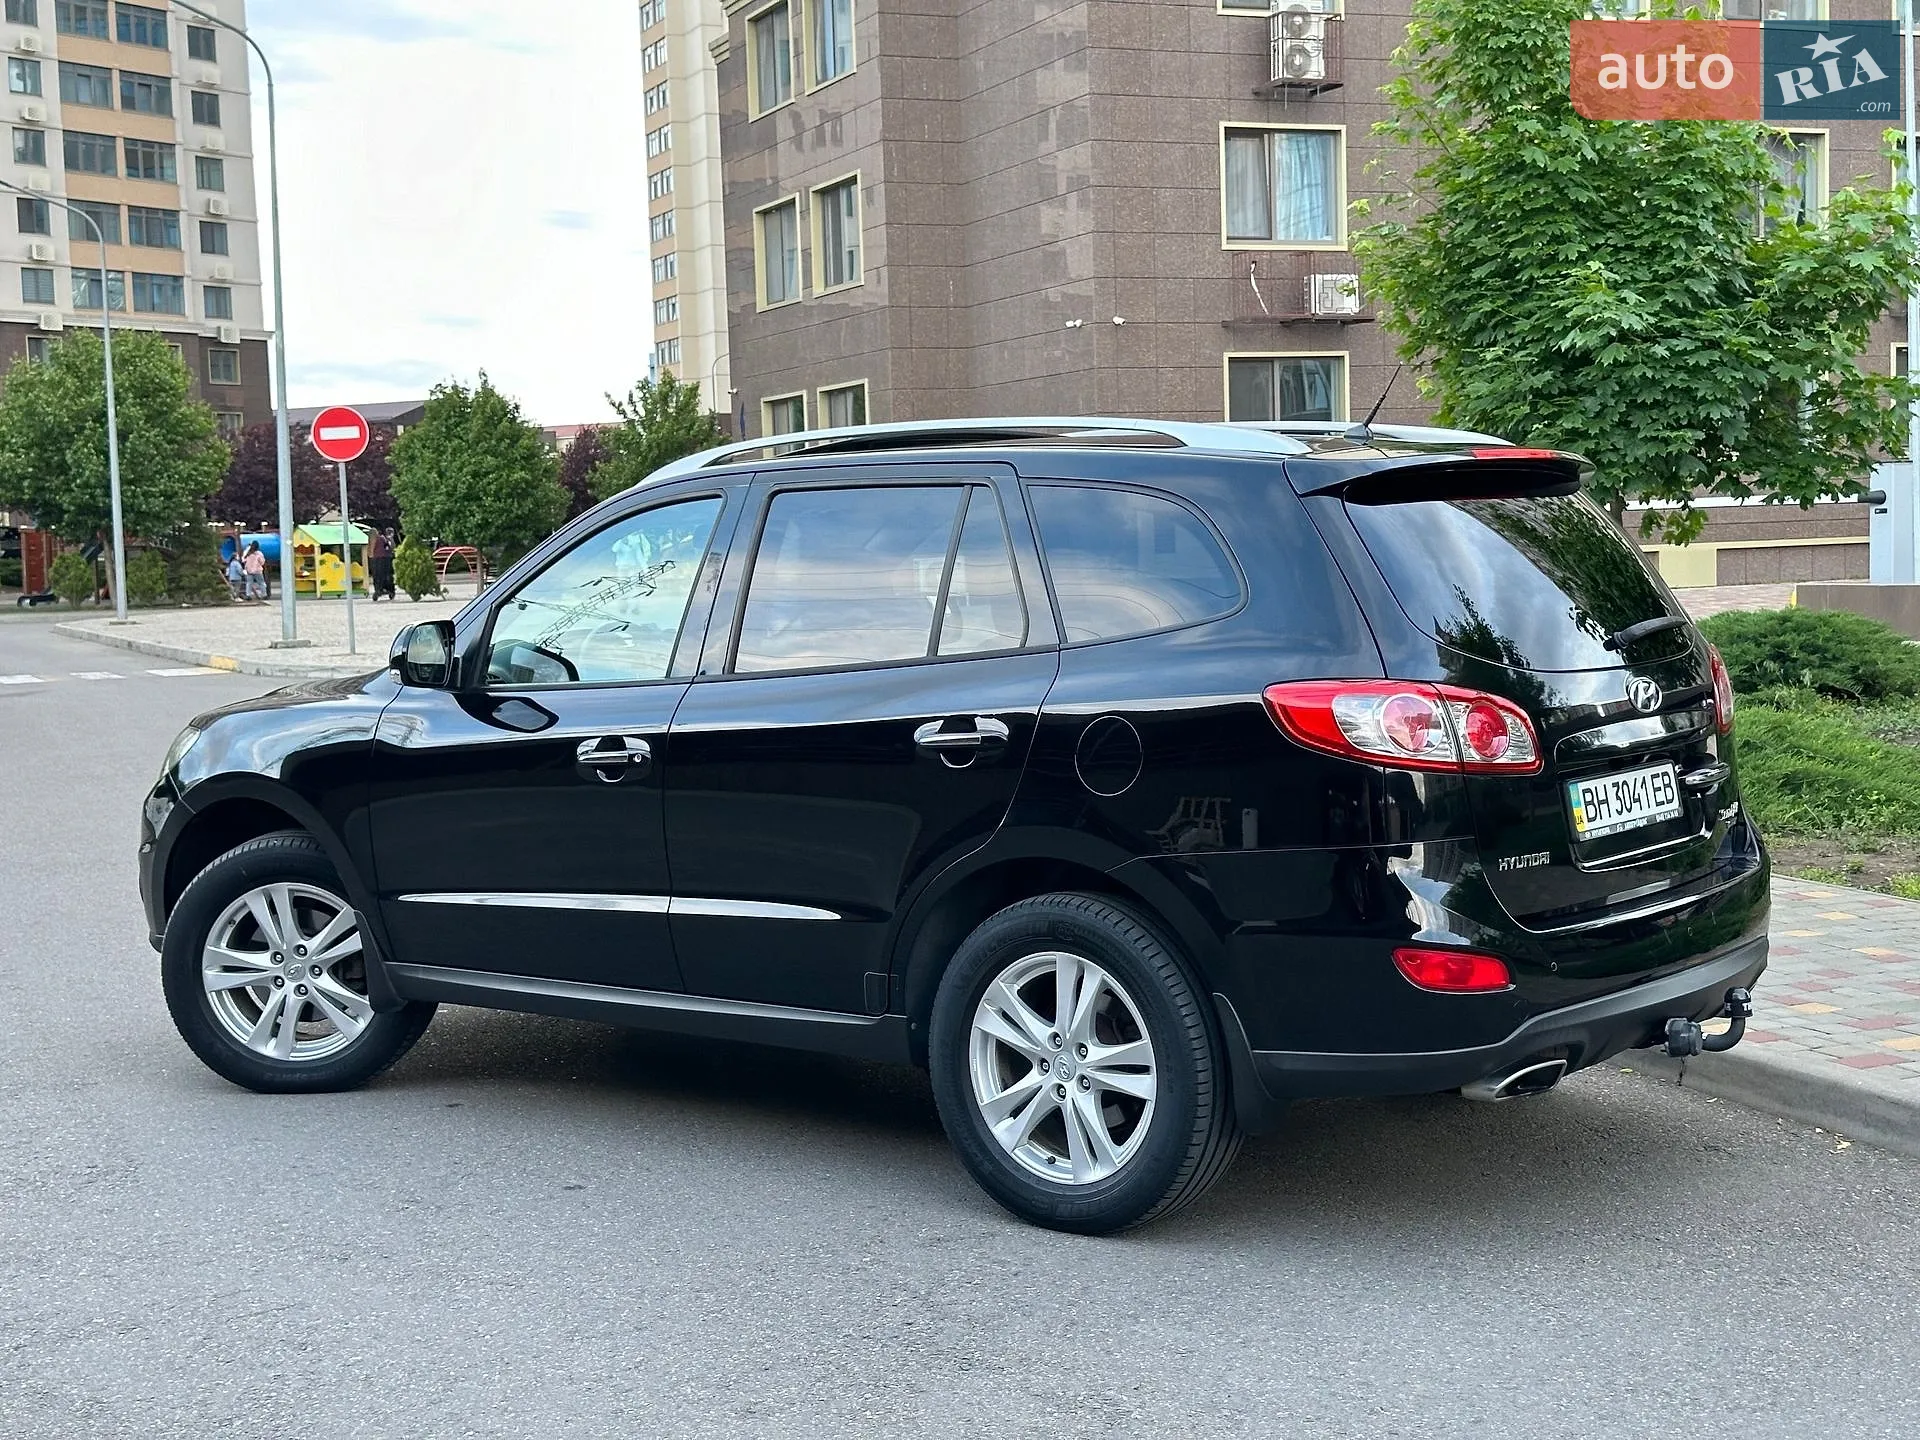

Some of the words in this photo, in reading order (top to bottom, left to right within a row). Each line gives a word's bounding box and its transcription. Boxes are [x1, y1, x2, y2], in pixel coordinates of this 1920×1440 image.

[1582, 783, 1611, 823] BH
[1612, 775, 1650, 816] 3041
[1650, 771, 1675, 807] EB
[1498, 851, 1550, 871] HYUNDAI
